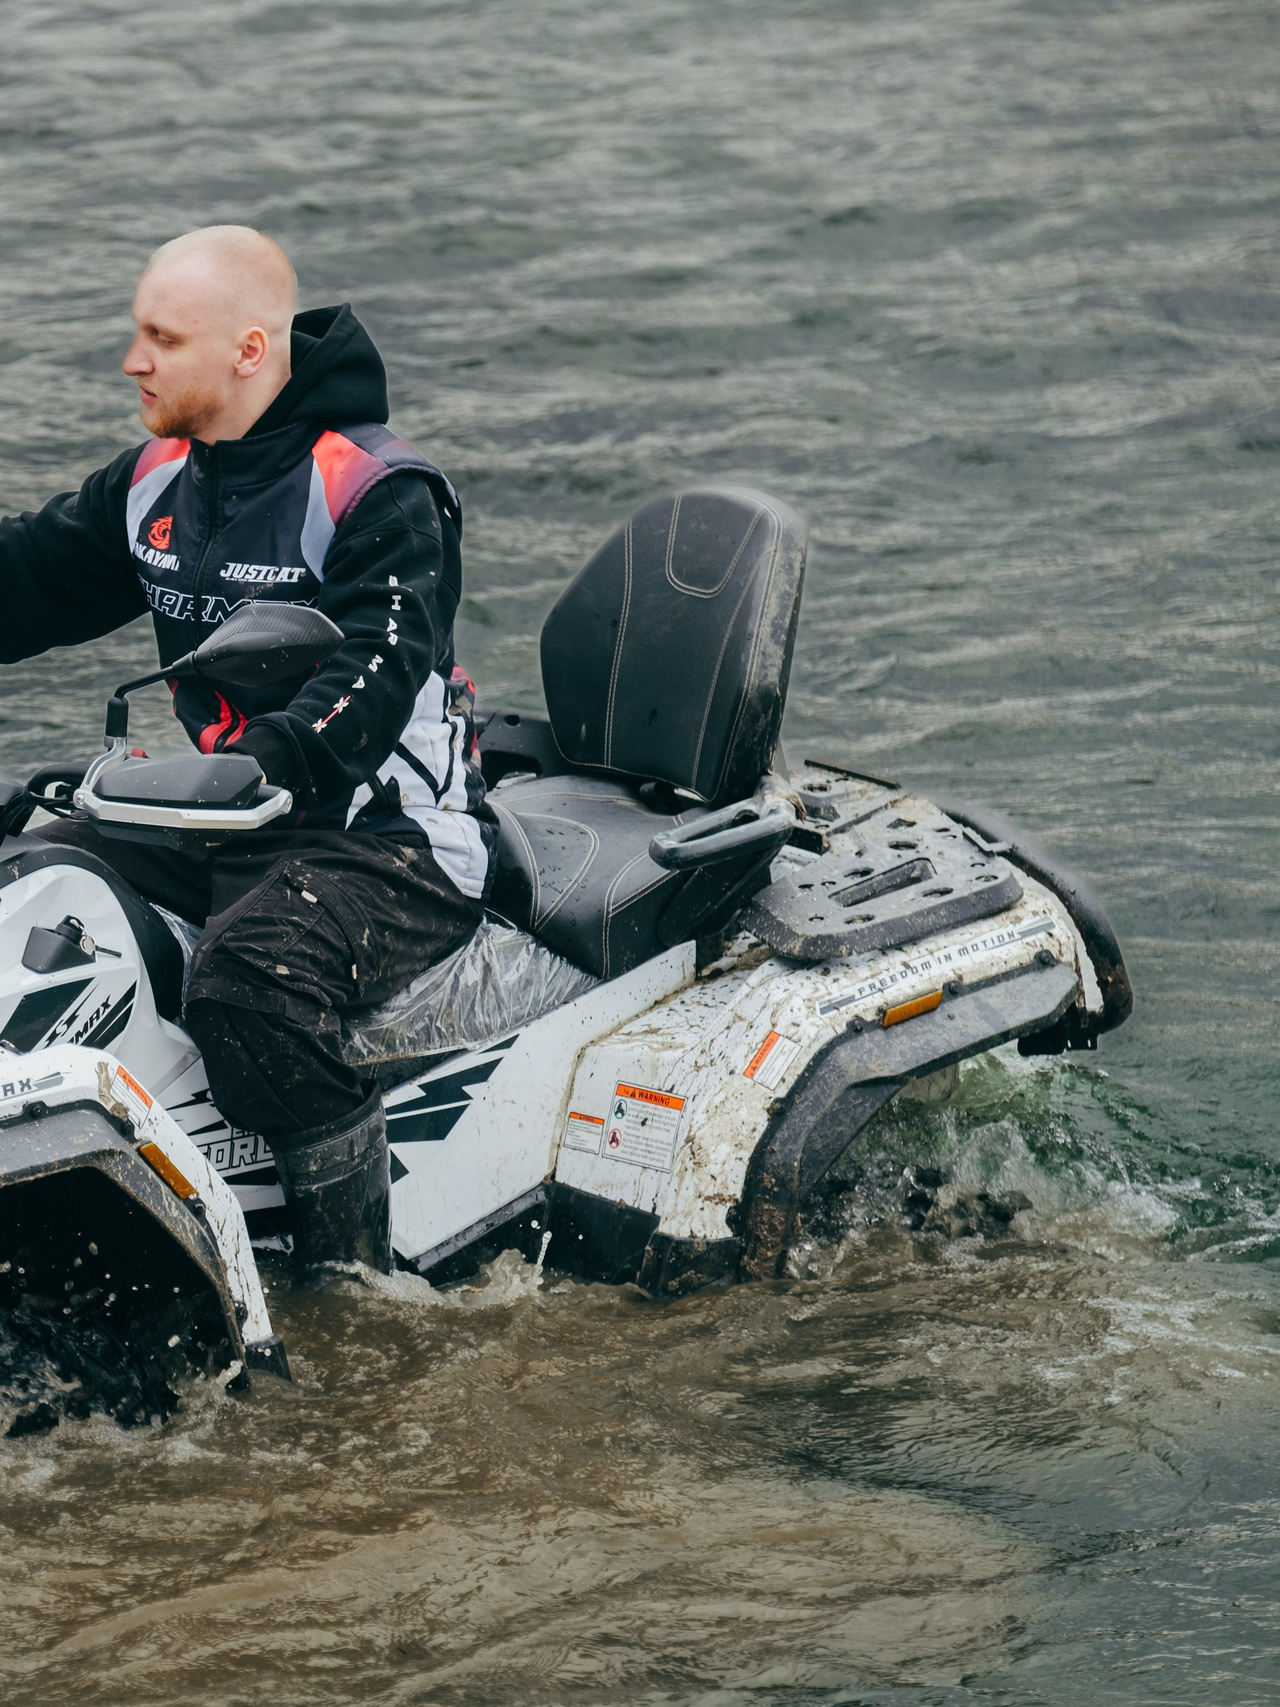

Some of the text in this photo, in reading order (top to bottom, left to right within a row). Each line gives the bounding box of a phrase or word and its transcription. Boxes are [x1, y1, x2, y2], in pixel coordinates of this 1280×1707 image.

[857, 931, 1016, 996] FREEDOM IN MOTION
[638, 1091, 671, 1106] WARNING
